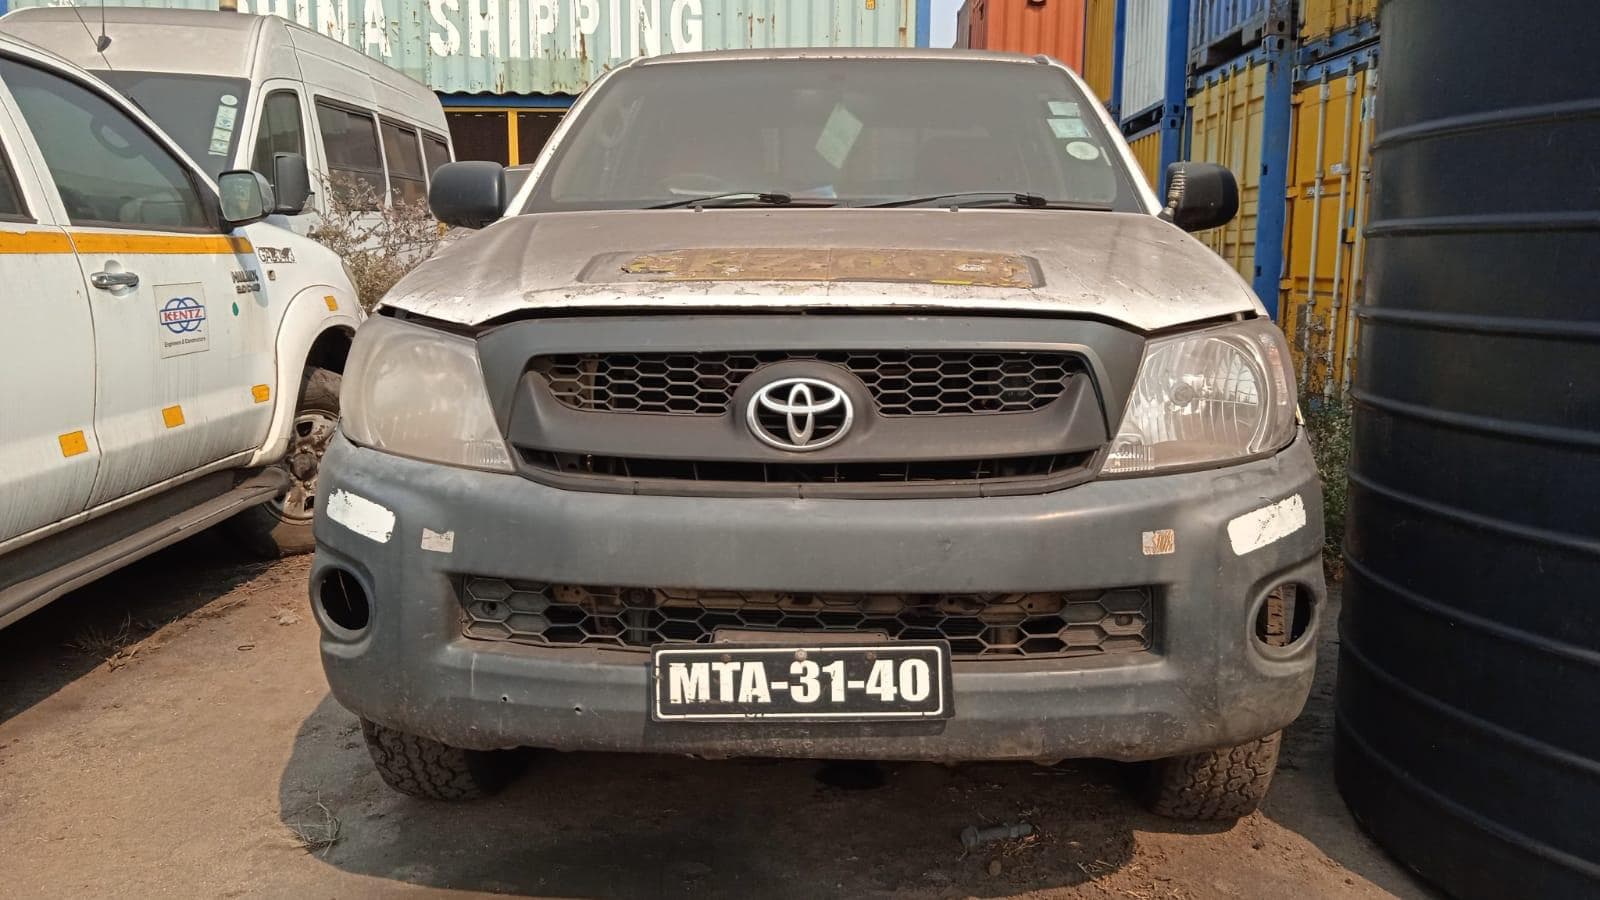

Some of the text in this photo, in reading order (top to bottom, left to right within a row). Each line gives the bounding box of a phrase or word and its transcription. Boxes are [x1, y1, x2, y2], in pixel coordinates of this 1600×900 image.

[429, 0, 703, 58] SHIPPING
[164, 308, 203, 322] KENTZ
[669, 658, 930, 704] MTA-31-40
